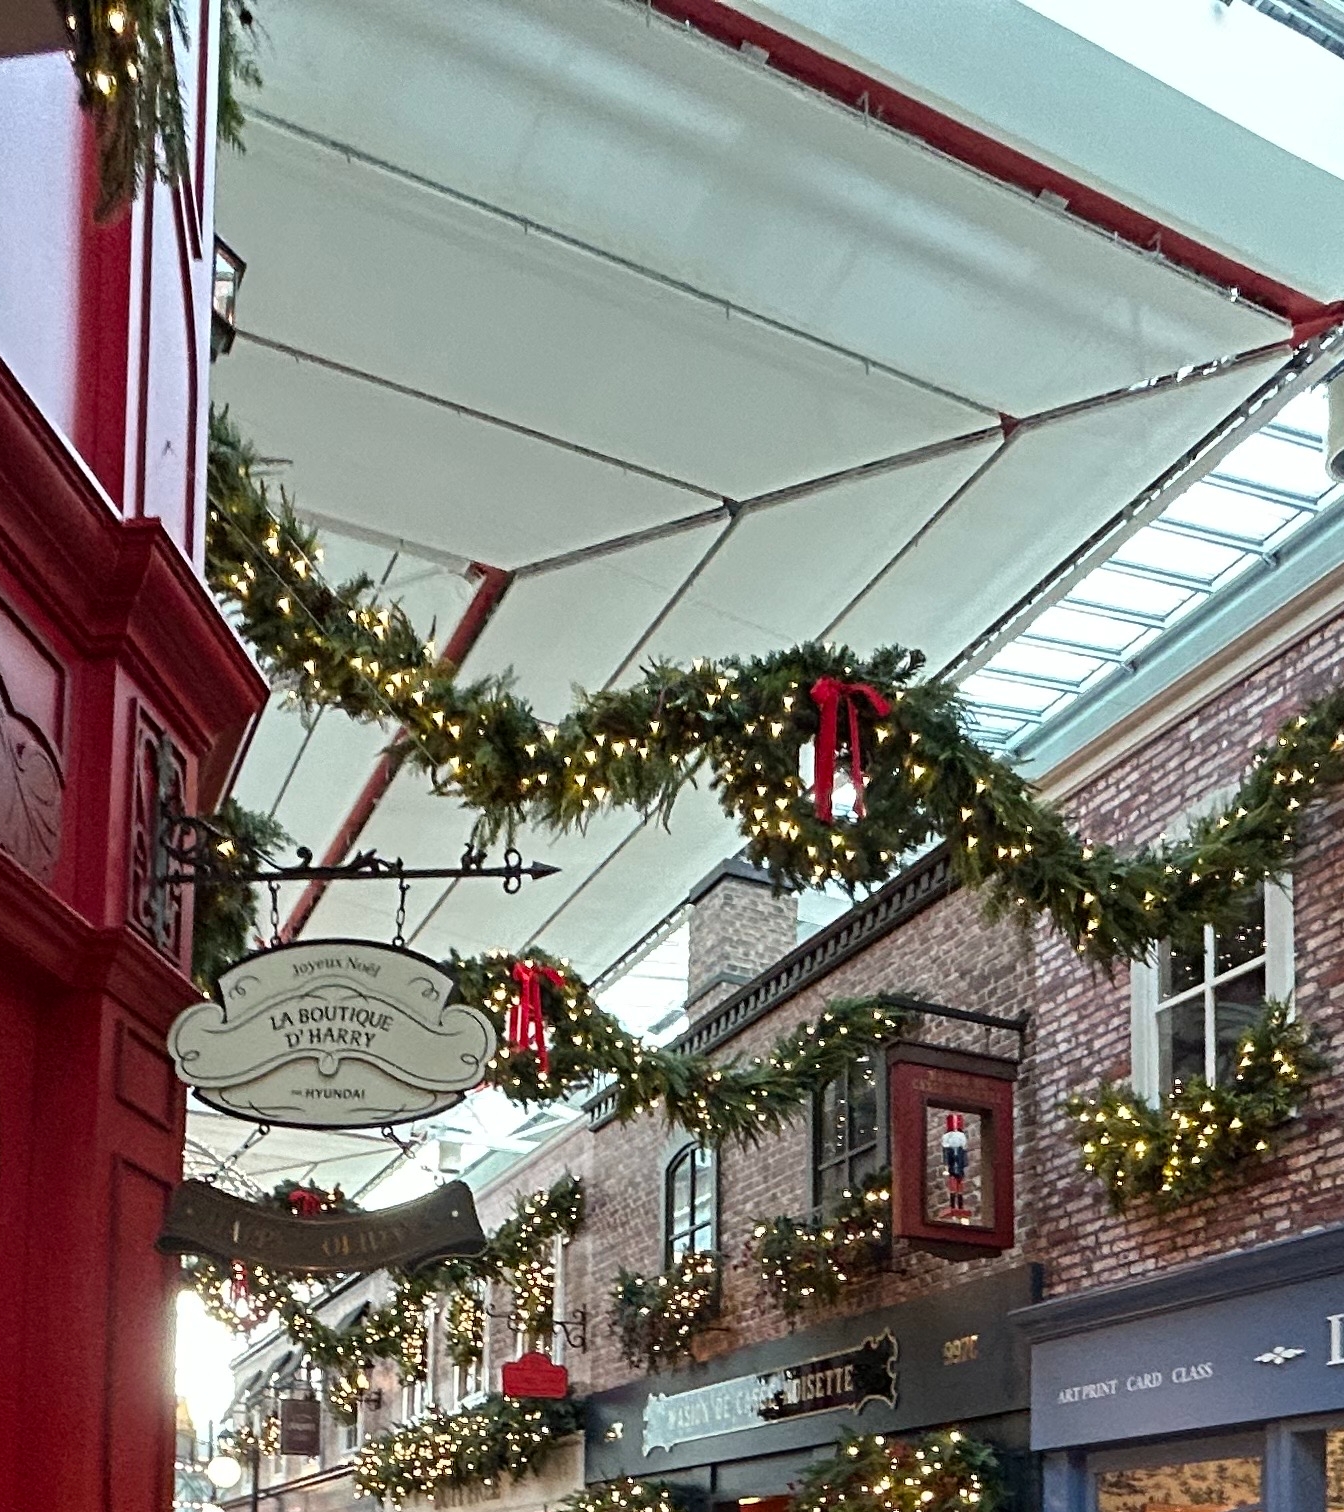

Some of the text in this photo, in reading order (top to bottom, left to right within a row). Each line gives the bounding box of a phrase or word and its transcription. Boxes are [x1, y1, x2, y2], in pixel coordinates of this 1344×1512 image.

[292, 956, 382, 978] Joyeux Noël
[269, 1005, 395, 1033] LA BOUTIQUE
[305, 1088, 366, 1100] HYUNDAI
[1126, 1371, 1163, 1392] CARD
[1171, 1361, 1215, 1384] CLASS
